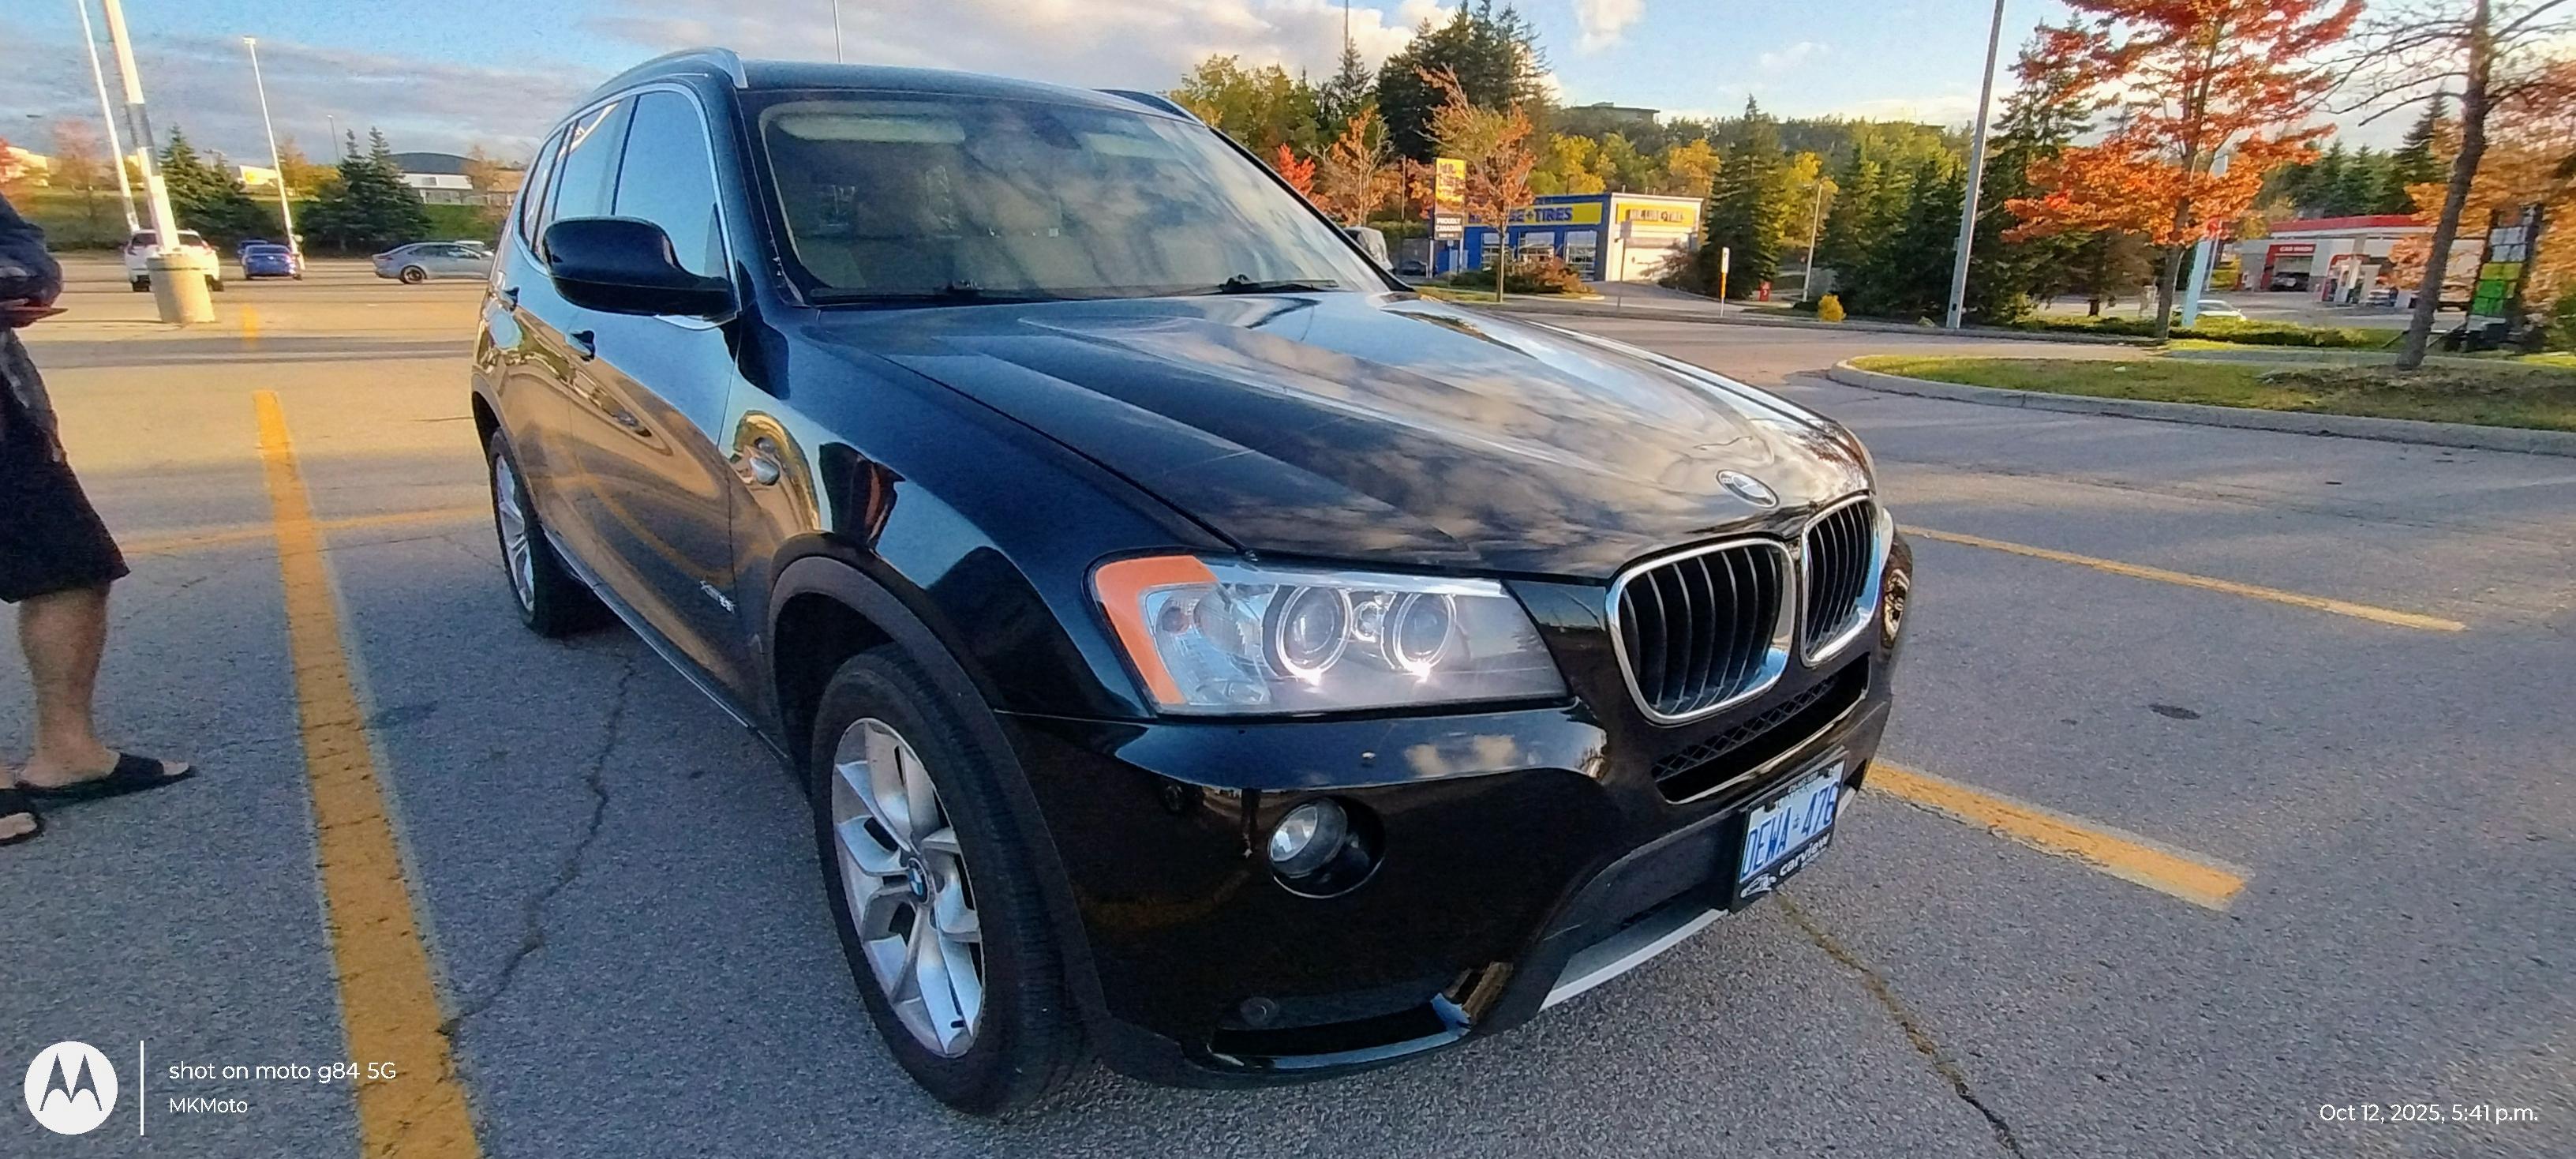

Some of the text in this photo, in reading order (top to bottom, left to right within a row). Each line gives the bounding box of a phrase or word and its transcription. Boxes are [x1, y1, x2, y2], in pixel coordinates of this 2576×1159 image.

[1534, 207, 1573, 223] TIRES
[1741, 805, 1792, 880] DEWA
[1800, 781, 1840, 837] 476
[1779, 832, 1831, 877] carview
